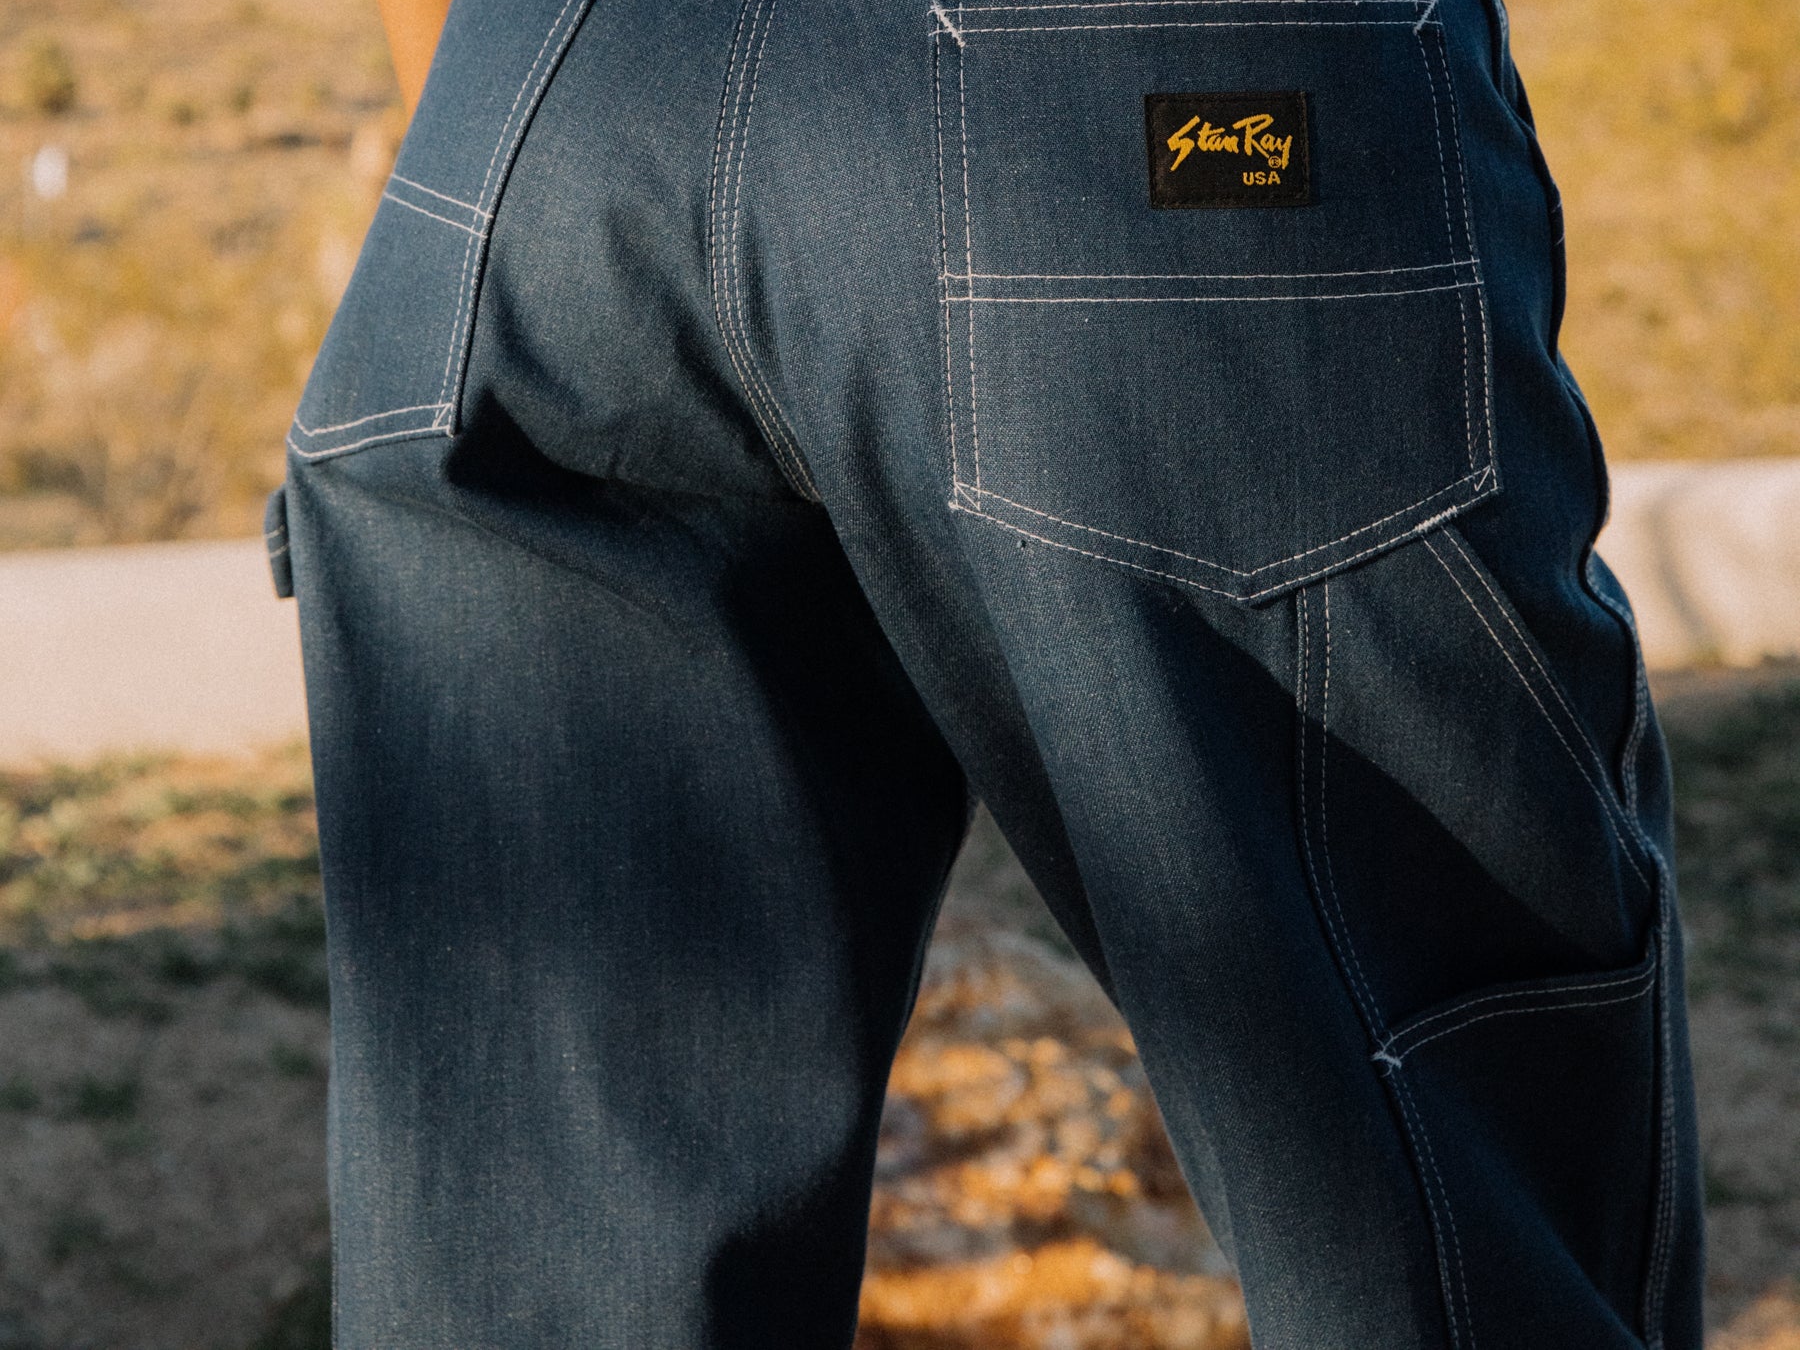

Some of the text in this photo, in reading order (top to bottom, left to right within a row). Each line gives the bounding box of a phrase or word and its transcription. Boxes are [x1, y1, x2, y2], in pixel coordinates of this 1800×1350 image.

[1167, 113, 1293, 171] Stan Ray
[1242, 171, 1281, 186] USA
